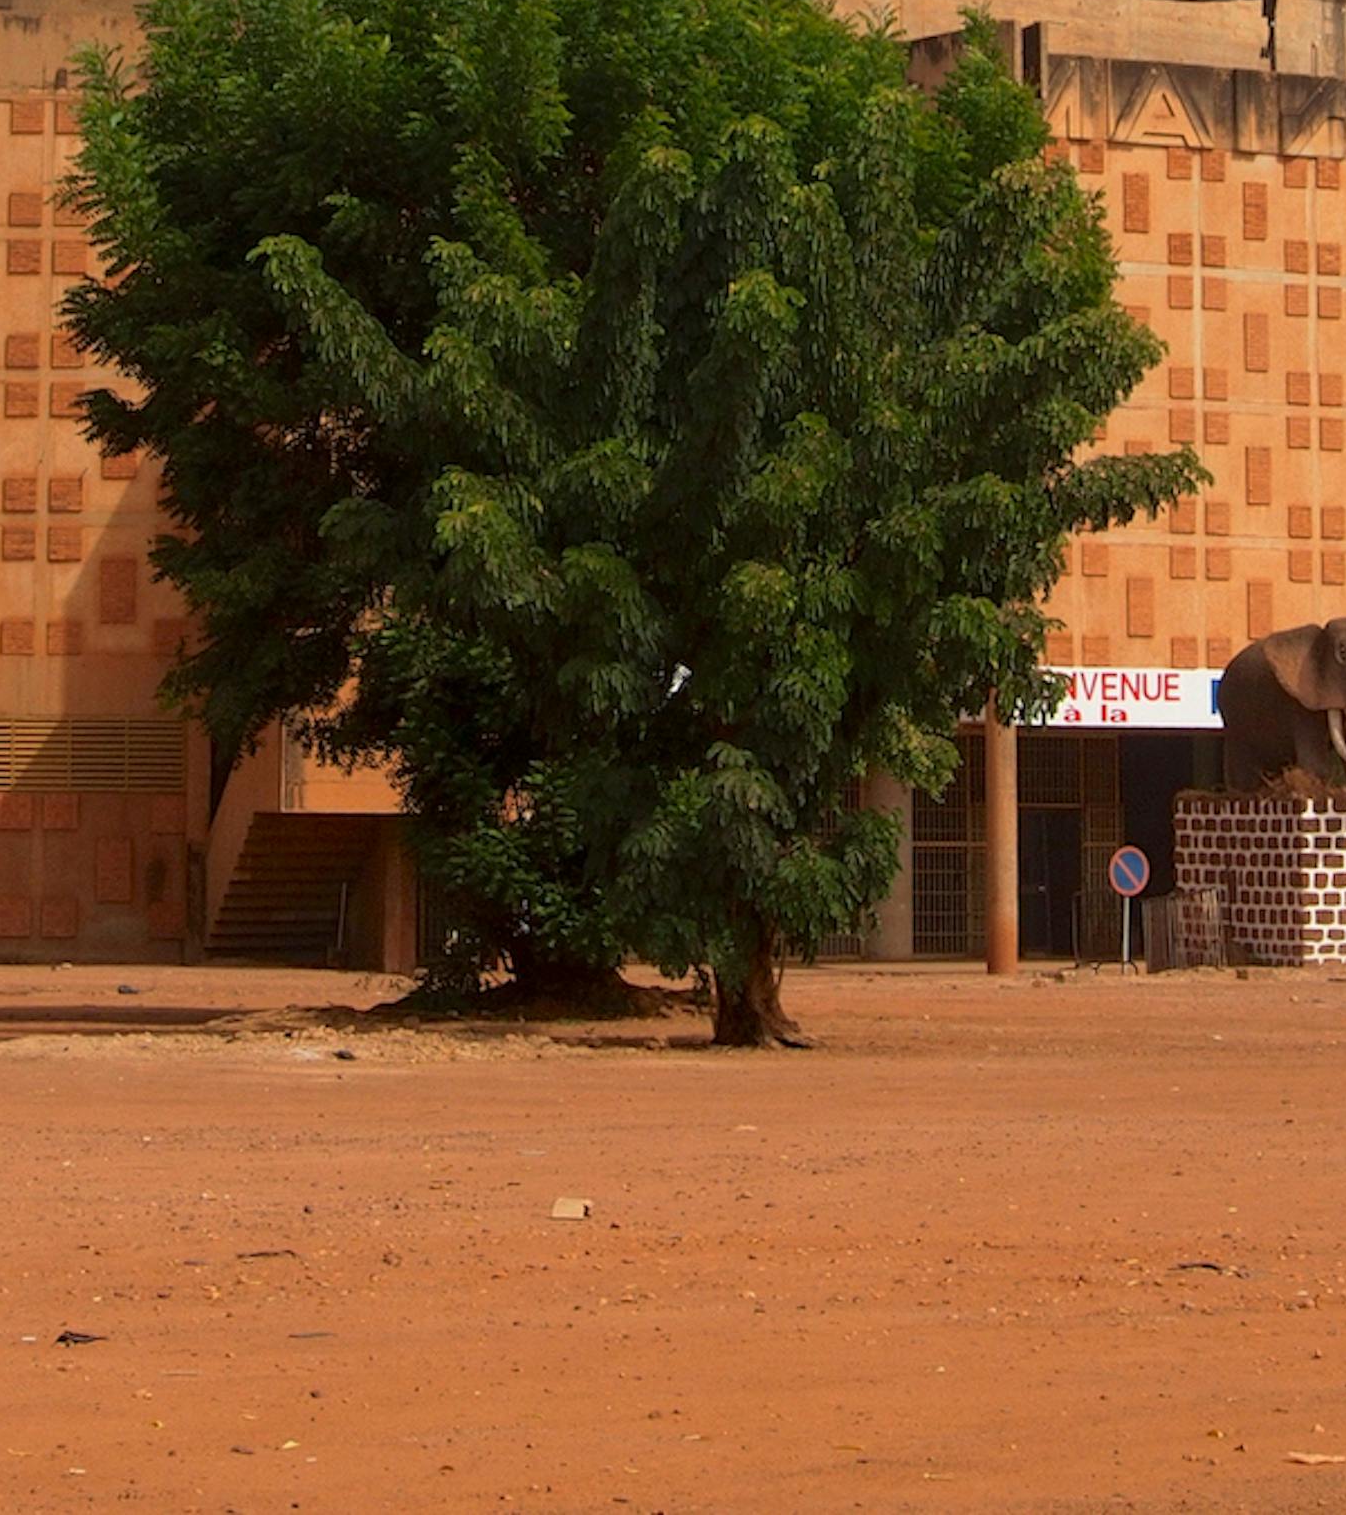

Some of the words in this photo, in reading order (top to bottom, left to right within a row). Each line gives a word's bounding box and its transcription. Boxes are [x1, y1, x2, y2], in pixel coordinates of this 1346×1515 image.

[1064, 672, 1181, 702] NVENUE
[1063, 705, 1082, 723] à
[1101, 704, 1128, 723] la
